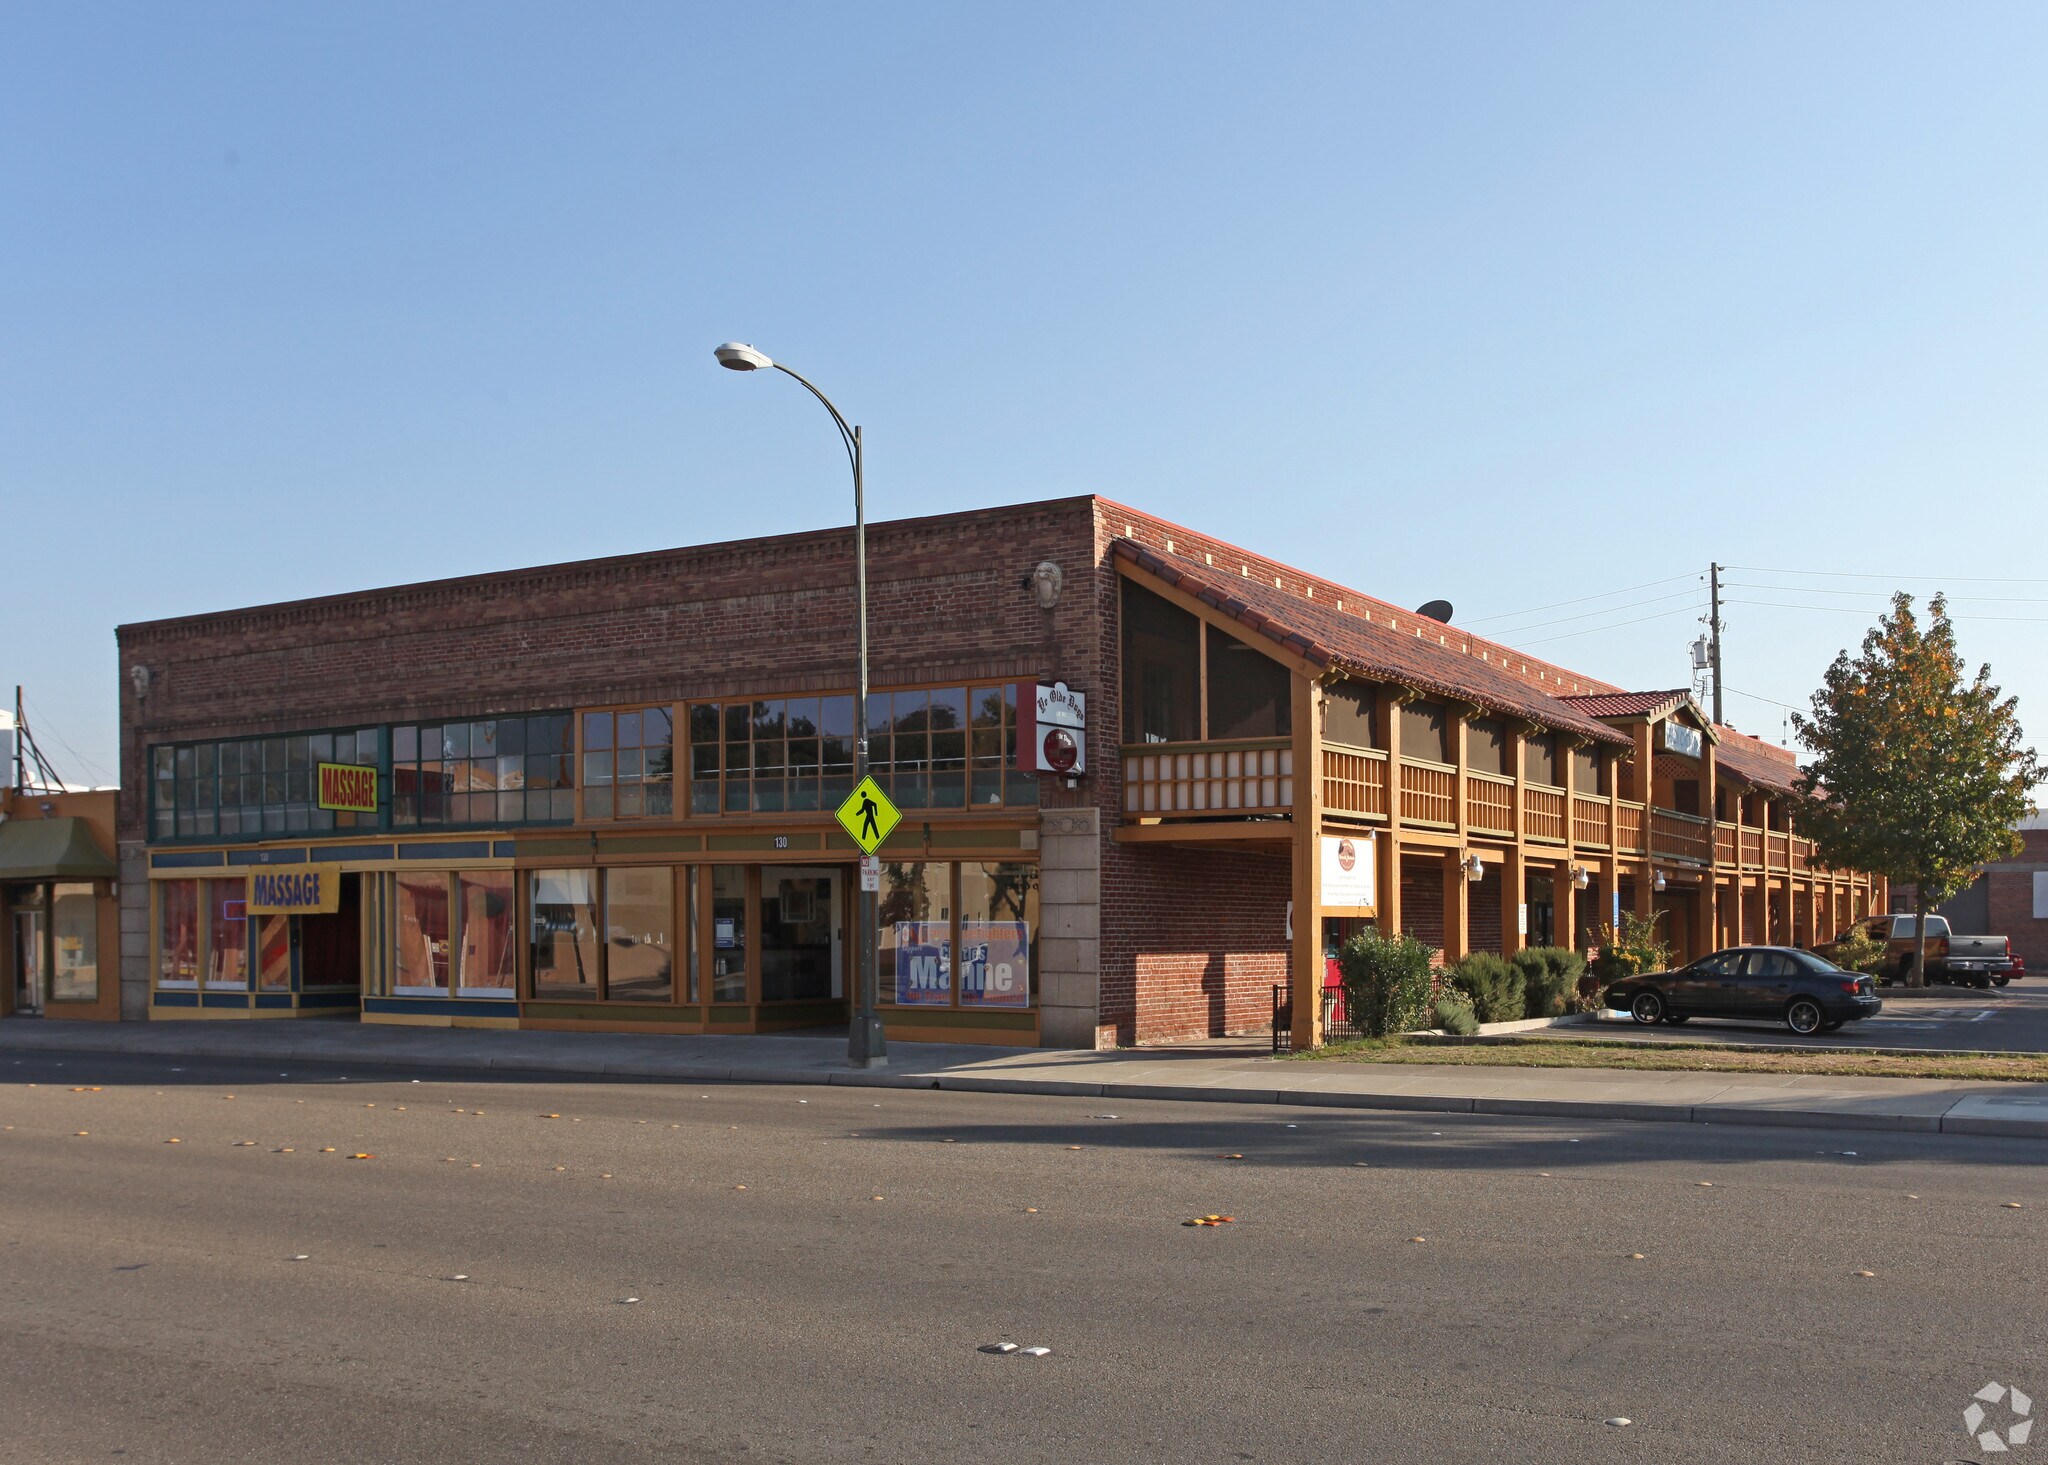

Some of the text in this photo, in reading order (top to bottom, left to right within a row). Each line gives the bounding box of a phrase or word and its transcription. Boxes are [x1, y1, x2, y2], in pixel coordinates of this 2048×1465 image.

[1049, 690, 1067, 703] Olde
[322, 767, 374, 808] MASSAGE
[774, 836, 788, 848] 130
[253, 873, 320, 906] MASSAGE
